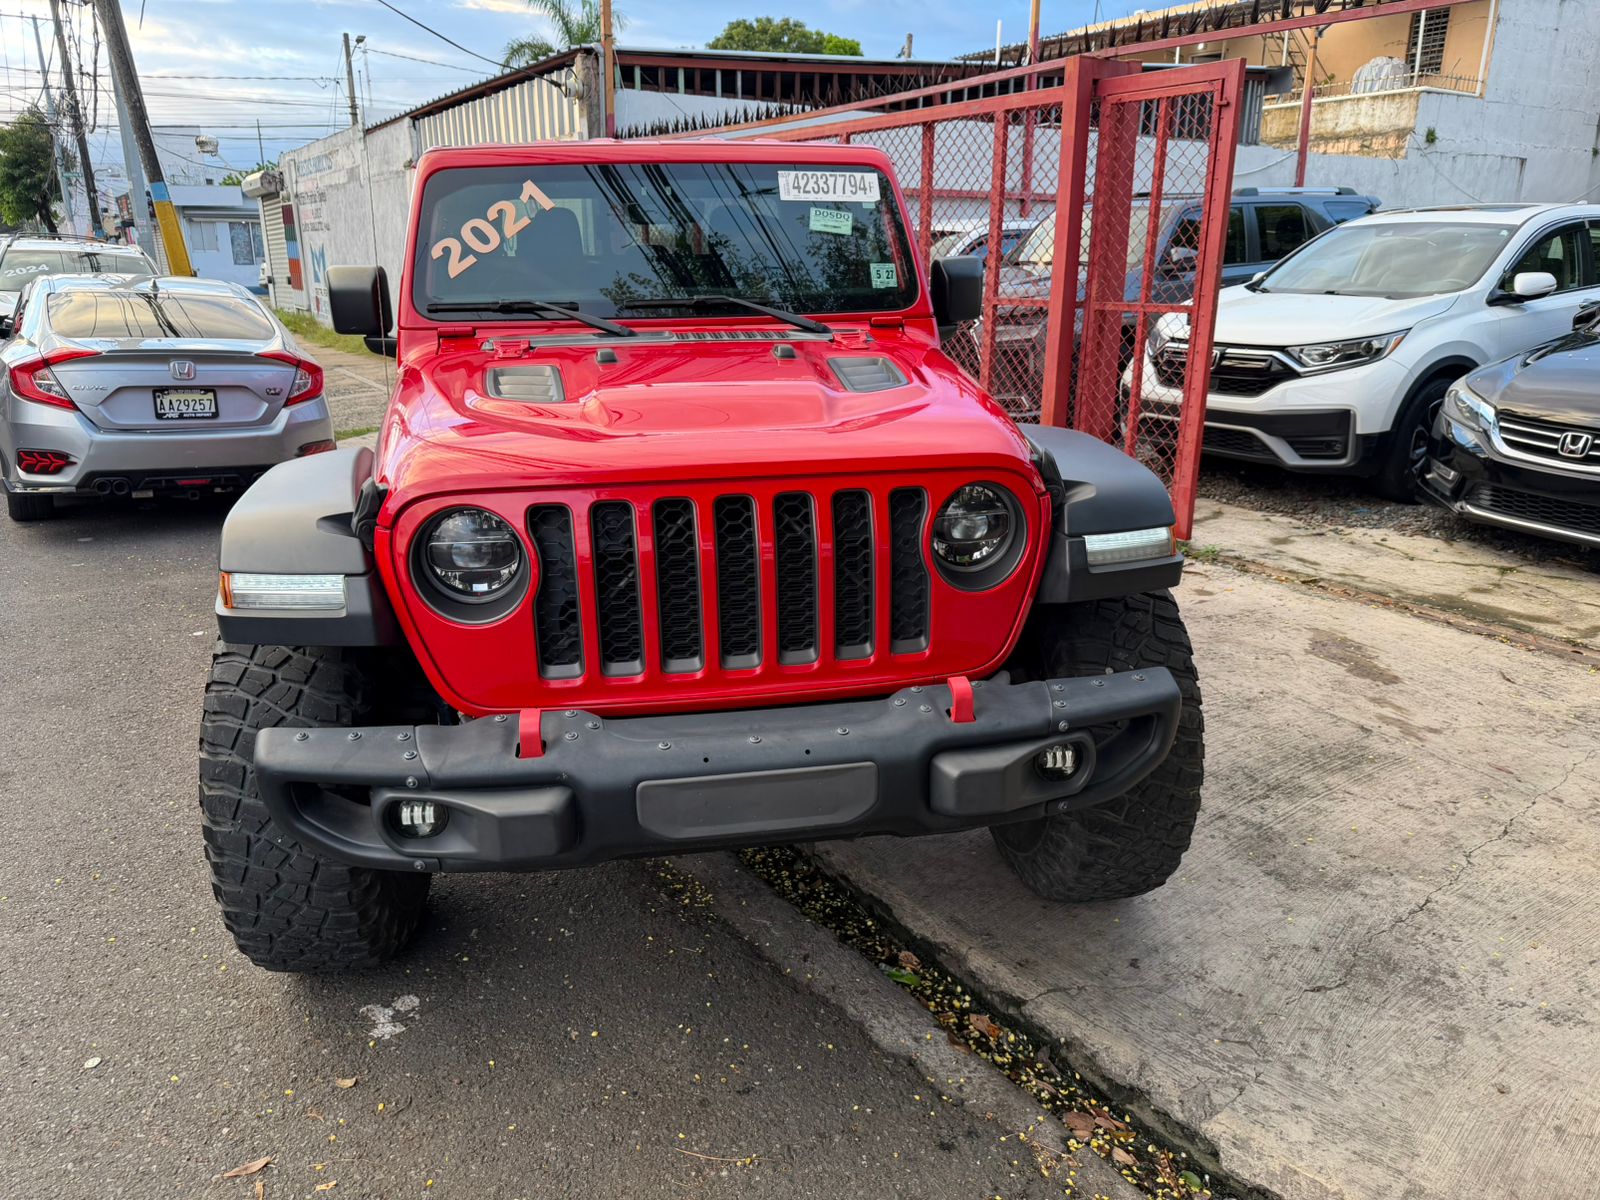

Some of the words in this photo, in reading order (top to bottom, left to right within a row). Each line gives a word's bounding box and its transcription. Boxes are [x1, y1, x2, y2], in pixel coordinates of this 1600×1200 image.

[792, 172, 868, 195] 42337794
[814, 209, 850, 222] DOSDQ
[431, 180, 556, 279] 2021
[4, 263, 50, 277] 2024
[876, 270, 881, 279] 5
[885, 270, 894, 279] 27
[159, 398, 213, 412] AA29257
